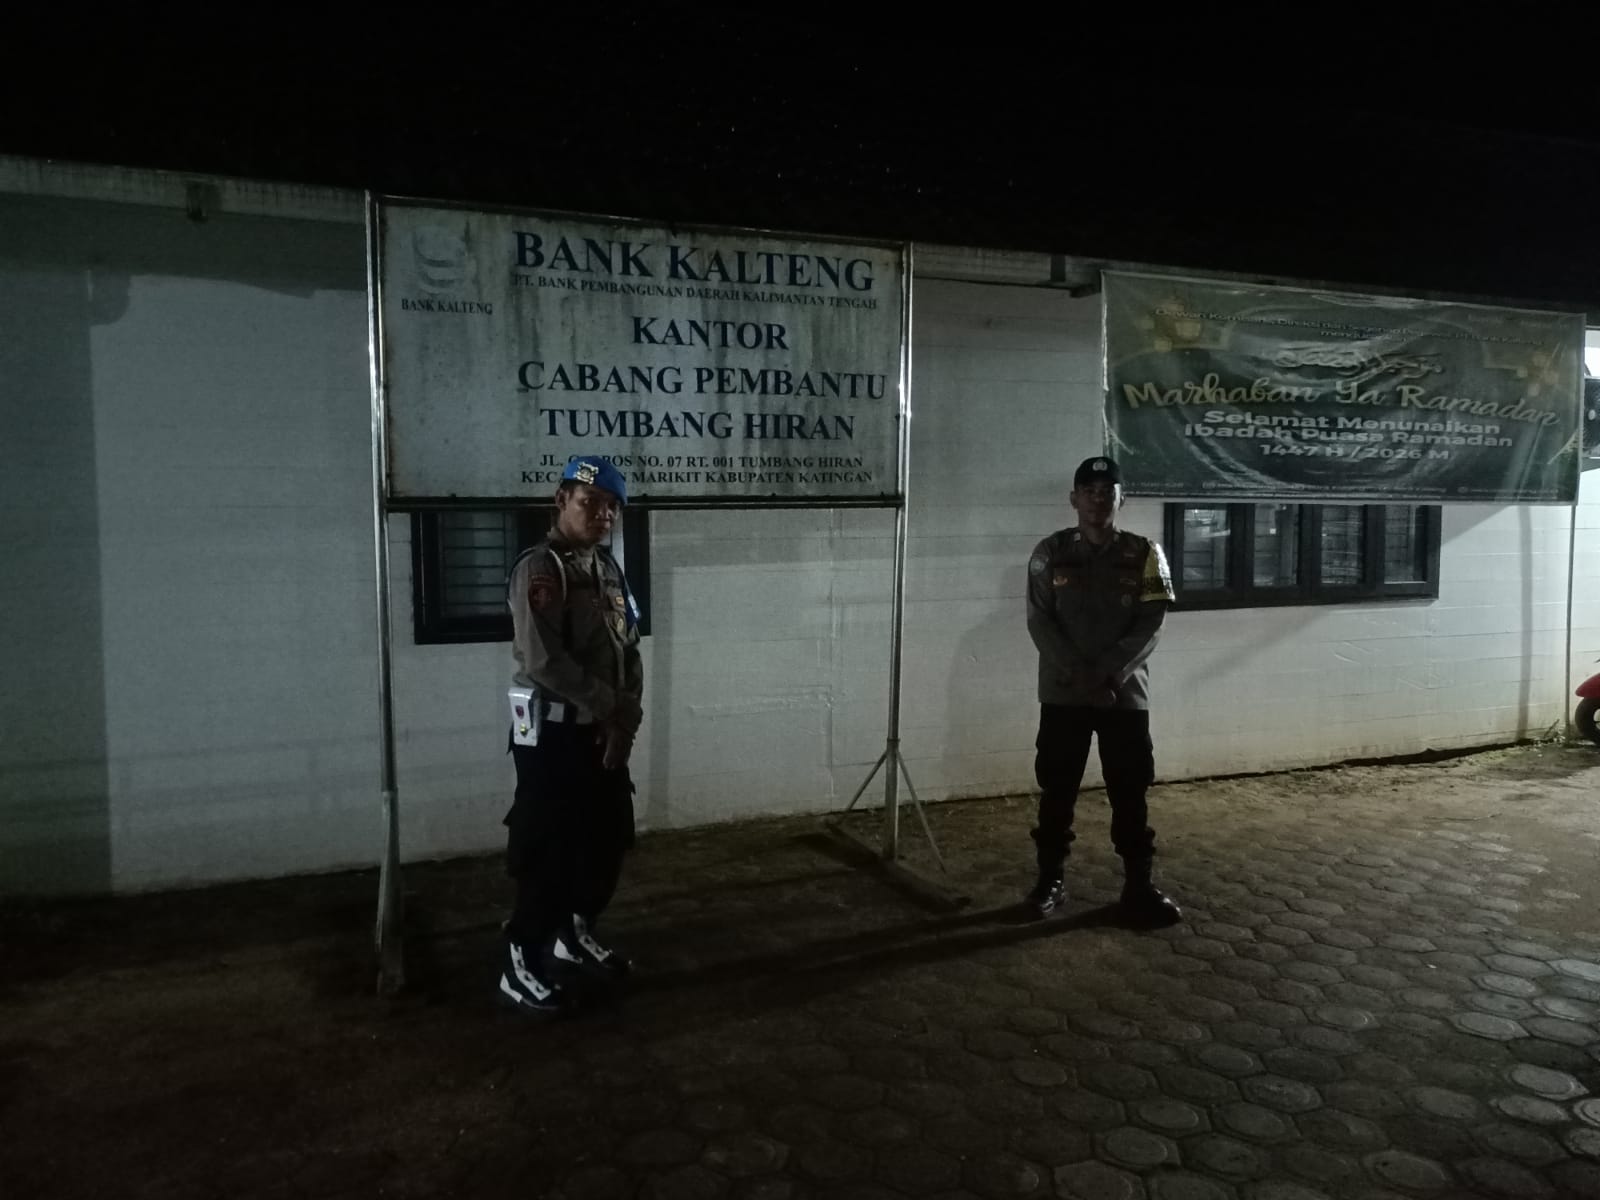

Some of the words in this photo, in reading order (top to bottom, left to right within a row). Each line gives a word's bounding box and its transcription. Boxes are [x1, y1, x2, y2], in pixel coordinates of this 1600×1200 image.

[513, 231, 652, 278] BANK
[667, 244, 874, 292] KALTENG
[512, 274, 534, 287] PT.
[539, 275, 577, 290] BANK
[581, 280, 683, 297] PEMBANGUNAN
[687, 287, 740, 301] DAERAH
[743, 290, 826, 305] KALIMANTAN
[829, 296, 878, 310] TENGAH
[401, 299, 435, 312] BANK
[438, 300, 493, 315] KALTENG
[632, 316, 788, 351] KANTOR
[518, 361, 683, 394] CABANG
[694, 367, 888, 400] PEMBANTU
[1122, 372, 1321, 409] Marhaban
[1335, 380, 1387, 405] Ya
[1397, 384, 1560, 426] Ramadan
[540, 408, 734, 439] TUMBANG
[744, 413, 855, 441] HIRAN
[1185, 423, 1292, 440] Ibadah
[1301, 429, 1384, 442] Puasa
[1392, 431, 1513, 447] Ramadan
[1203, 410, 1330, 429] Selamat
[1337, 416, 1500, 435] Menunaikan
[540, 454, 564, 467] JL.
[638, 455, 663, 468] NO.
[667, 456, 682, 468] 07
[687, 457, 709, 469] RT.
[713, 457, 733, 468] 001
[739, 457, 813, 468] TUMBANG
[818, 457, 863, 468] HIRAN
[1260, 444, 1316, 456] 1447
[1429, 450, 1449, 460] M
[632, 471, 701, 483] MARIKIT
[706, 471, 798, 483] KABUPATEN
[800, 472, 872, 484] KATINGAN
